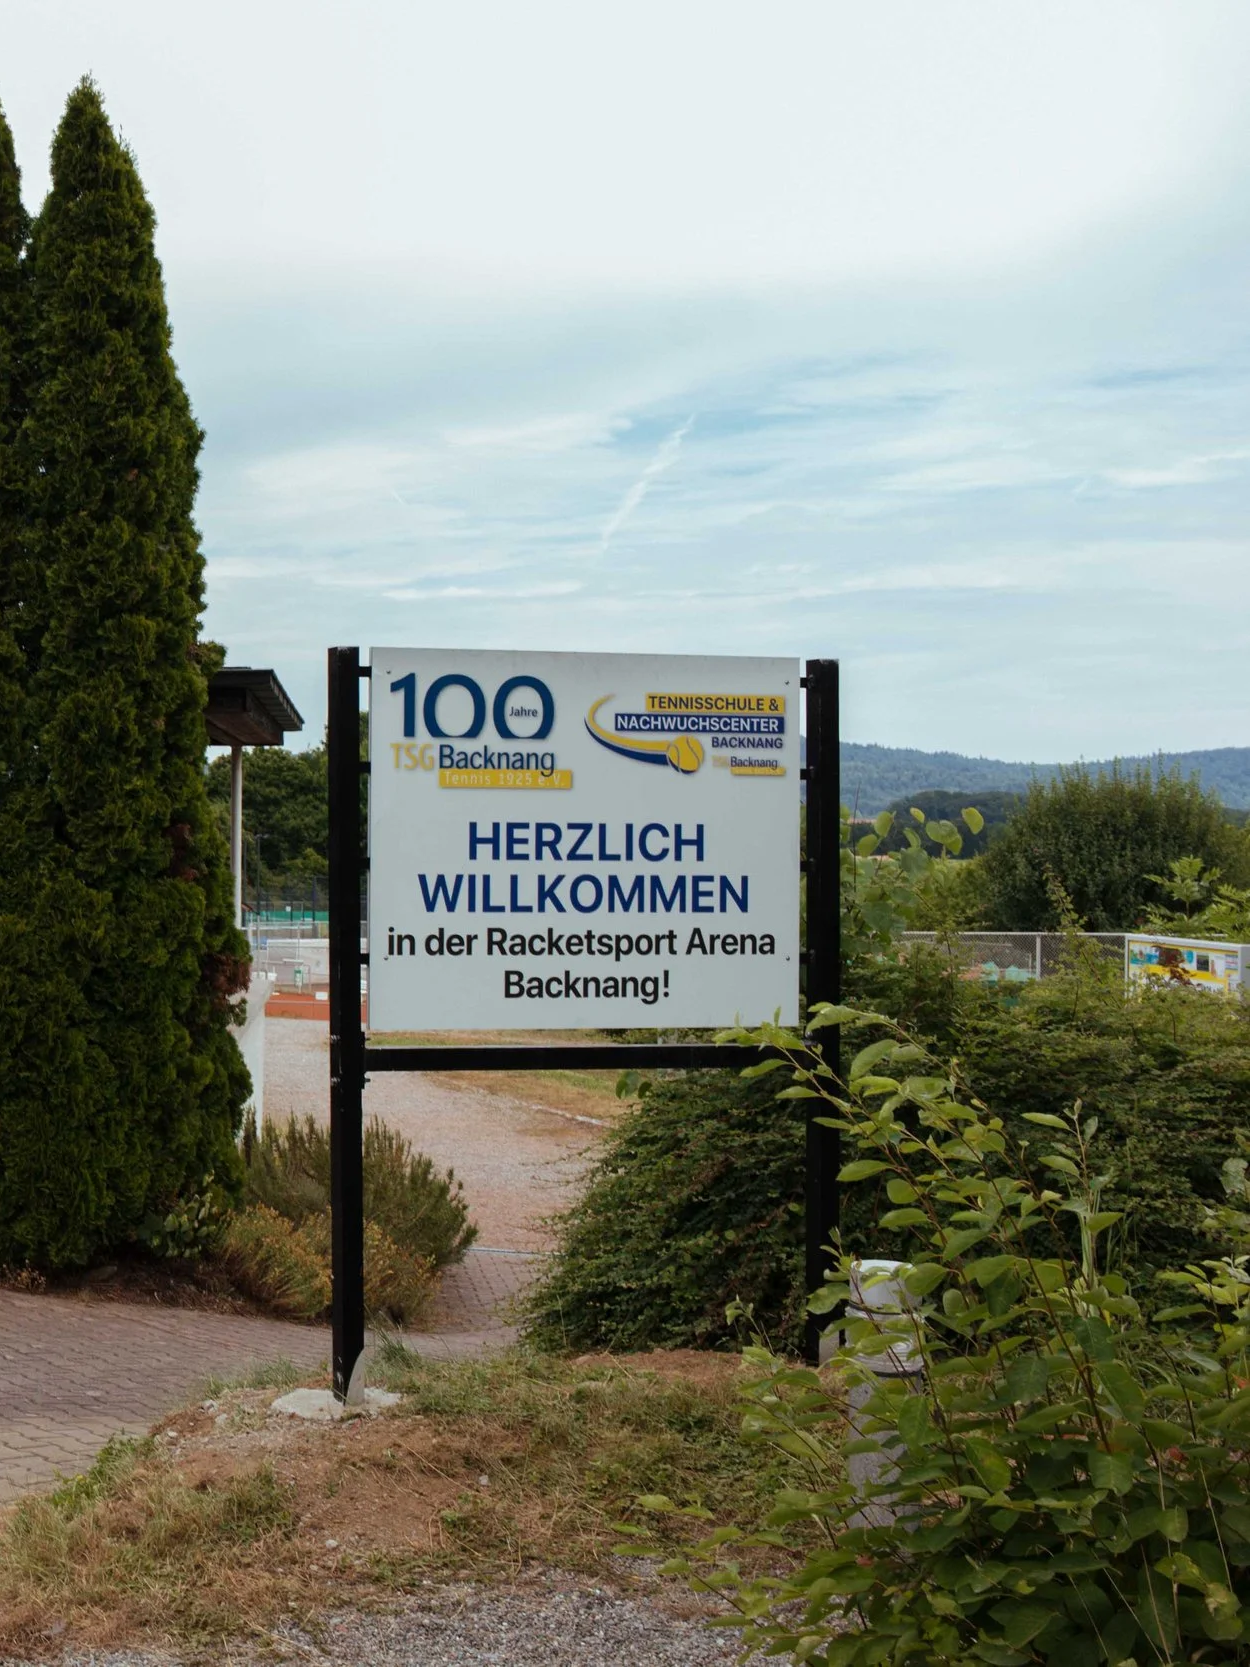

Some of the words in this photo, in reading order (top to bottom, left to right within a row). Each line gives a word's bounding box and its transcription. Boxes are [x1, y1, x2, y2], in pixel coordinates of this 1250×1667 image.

[390, 672, 555, 739] 100
[509, 706, 538, 718] Jahre
[648, 695, 765, 711] TENNISSCHULE
[768, 698, 780, 712] &
[616, 714, 779, 732] NACHWUCHSCENTER
[711, 736, 784, 749] BACKNANG
[390, 743, 435, 771] TSG
[438, 743, 555, 777] Backnang
[730, 756, 779, 770] Backnang
[444, 771, 492, 785] Tennis
[499, 772, 533, 786] 1925
[468, 821, 705, 863] HERZLICH
[417, 873, 749, 914] WILLKOMMEN
[388, 926, 416, 956] in
[424, 927, 479, 956] der
[486, 927, 678, 962] Racketsport
[685, 927, 776, 956] Arena
[504, 969, 670, 1005] Backnang!
